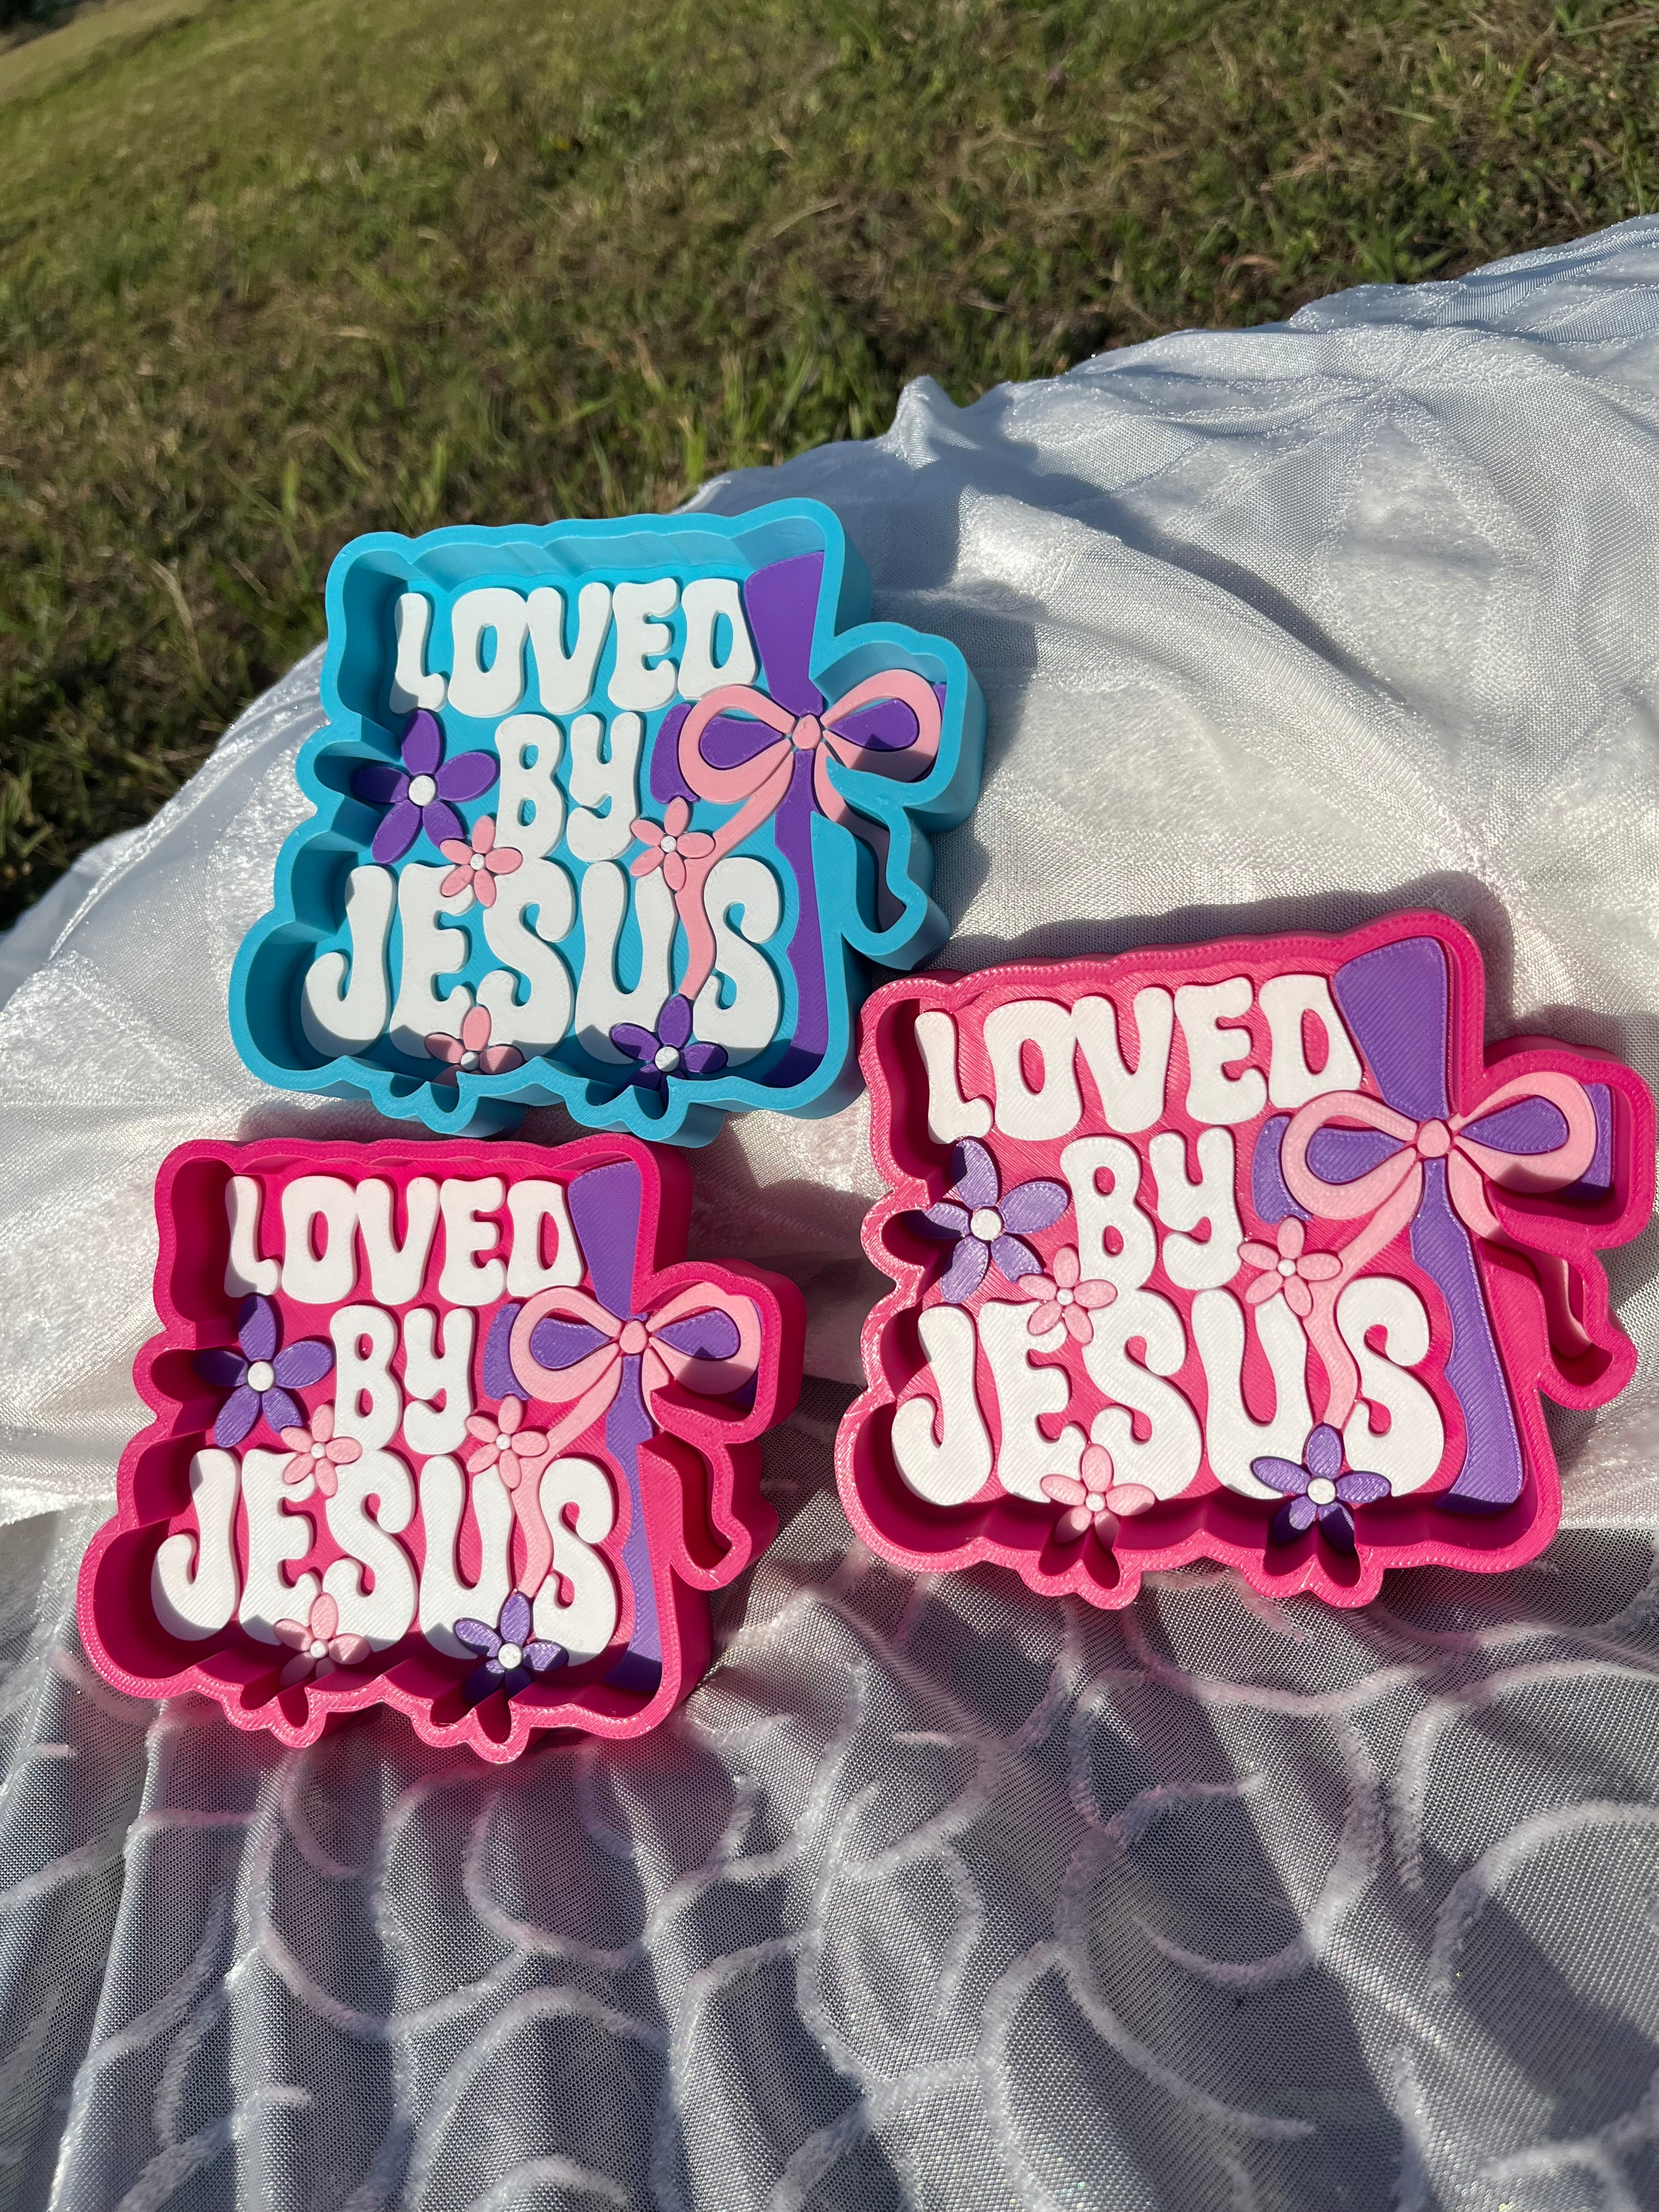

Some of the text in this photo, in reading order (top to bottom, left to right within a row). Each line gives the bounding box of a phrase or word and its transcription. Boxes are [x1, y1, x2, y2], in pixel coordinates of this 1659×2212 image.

[389, 578, 757, 717] LOVED
[494, 712, 645, 862] BY
[302, 856, 784, 1066] JESUS
[915, 974, 1363, 1143] LOVED
[225, 1176, 584, 1306] LOVED
[1061, 1125, 1245, 1290] BY
[329, 1305, 475, 1454] BY
[891, 1276, 1445, 1505] JESUS
[151, 1448, 619, 1666] JESUS
